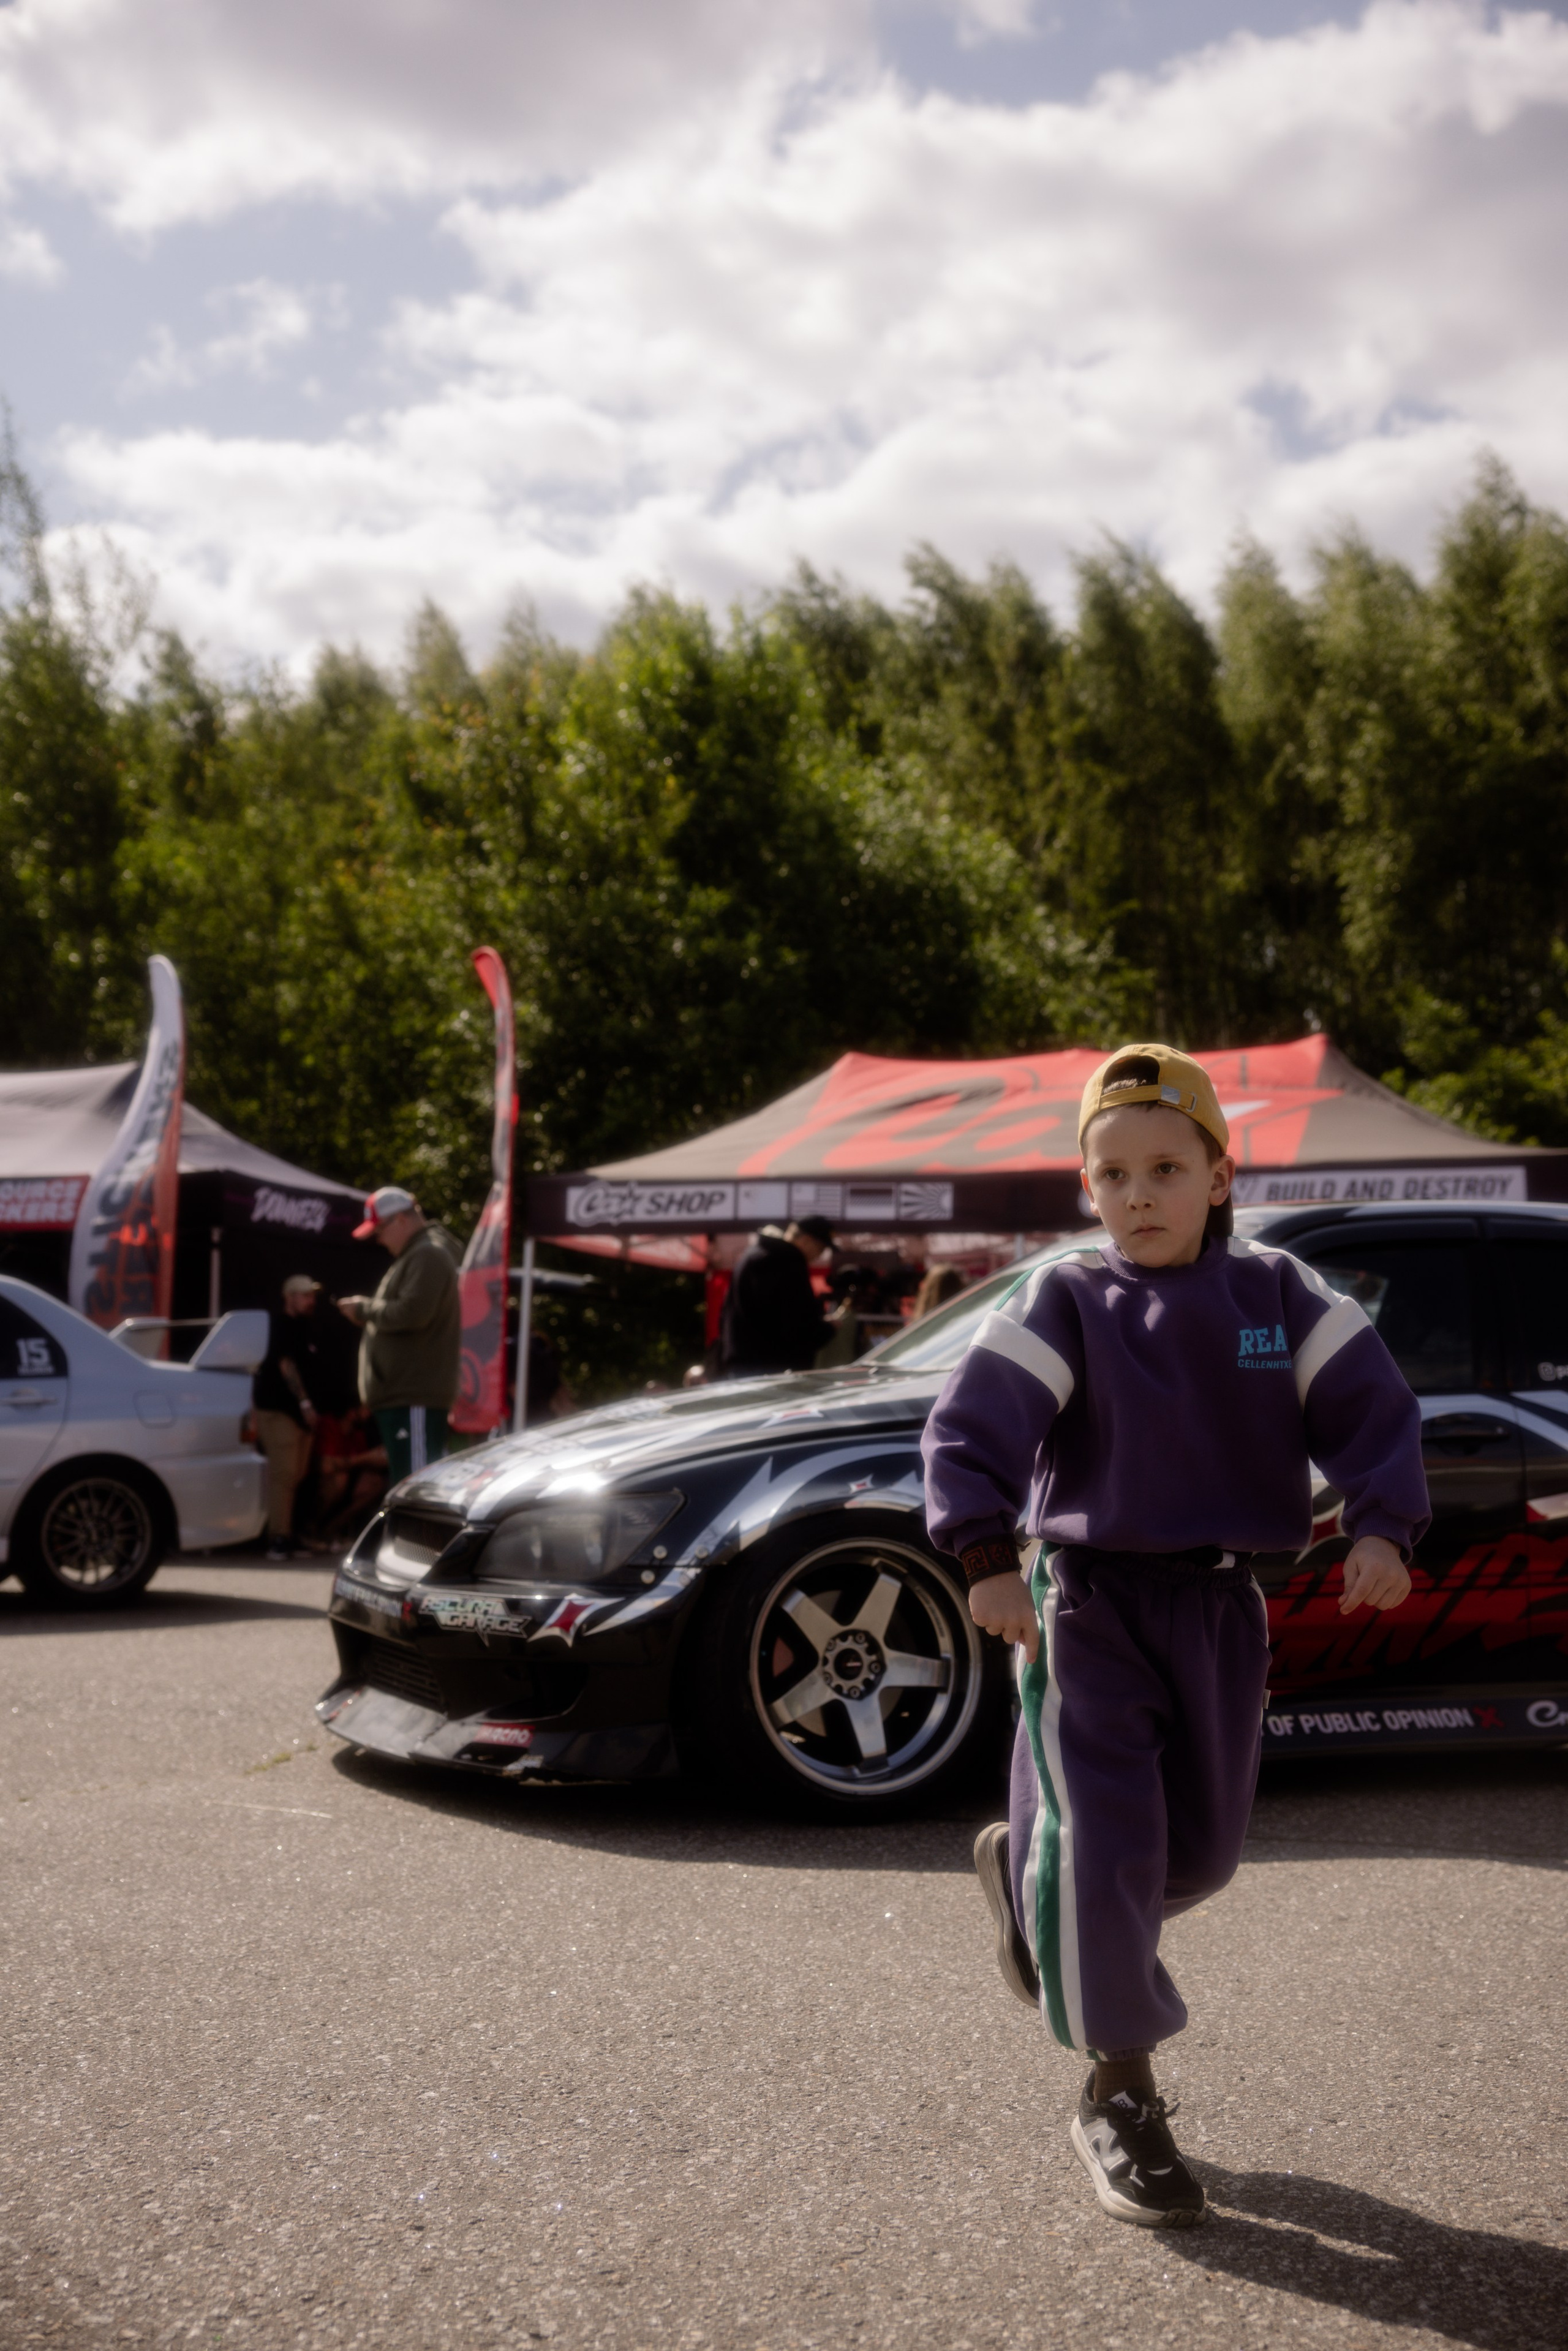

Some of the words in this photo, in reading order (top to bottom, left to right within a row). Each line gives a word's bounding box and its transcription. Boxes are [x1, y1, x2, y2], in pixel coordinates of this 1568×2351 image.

[1265, 1178, 1334, 1201] BUILD
[1343, 1177, 1394, 1199] AND
[1403, 1174, 1514, 1199] DESTROY
[644, 1190, 726, 1215] SHOP
[15, 1337, 50, 1367] 15
[1238, 1324, 1287, 1357] REA
[446, 1613, 524, 1634] GARAGE
[1266, 1714, 1295, 1737] OF
[1300, 1709, 1381, 1735] PUBLIC
[1382, 1707, 1475, 1731] OPINION
